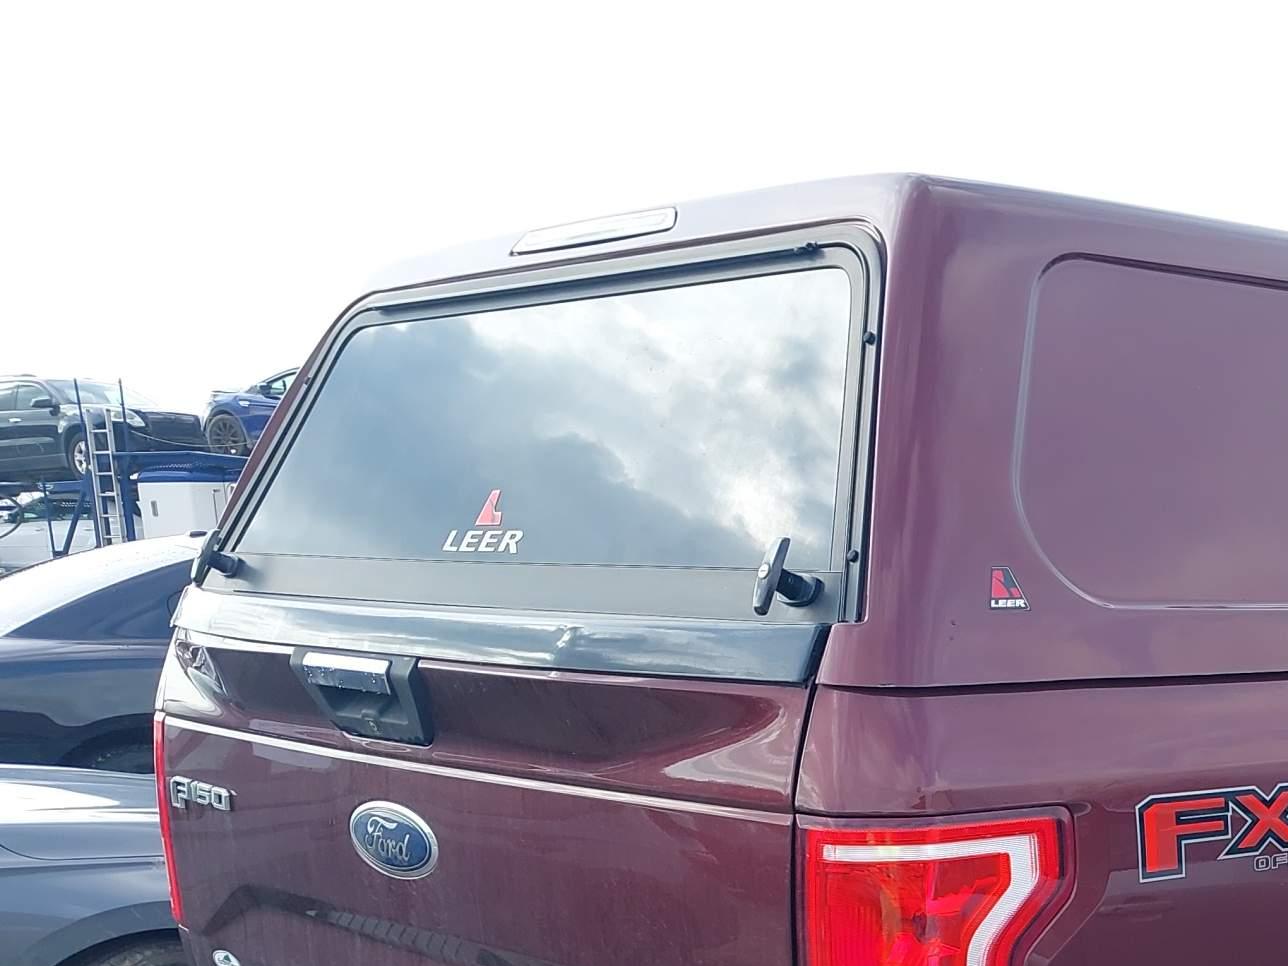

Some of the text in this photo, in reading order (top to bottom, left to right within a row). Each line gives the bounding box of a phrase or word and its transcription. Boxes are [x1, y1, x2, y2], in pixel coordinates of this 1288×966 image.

[443, 529, 524, 554] LEER
[990, 598, 1026, 608] LEER
[364, 815, 410, 862] Ford
